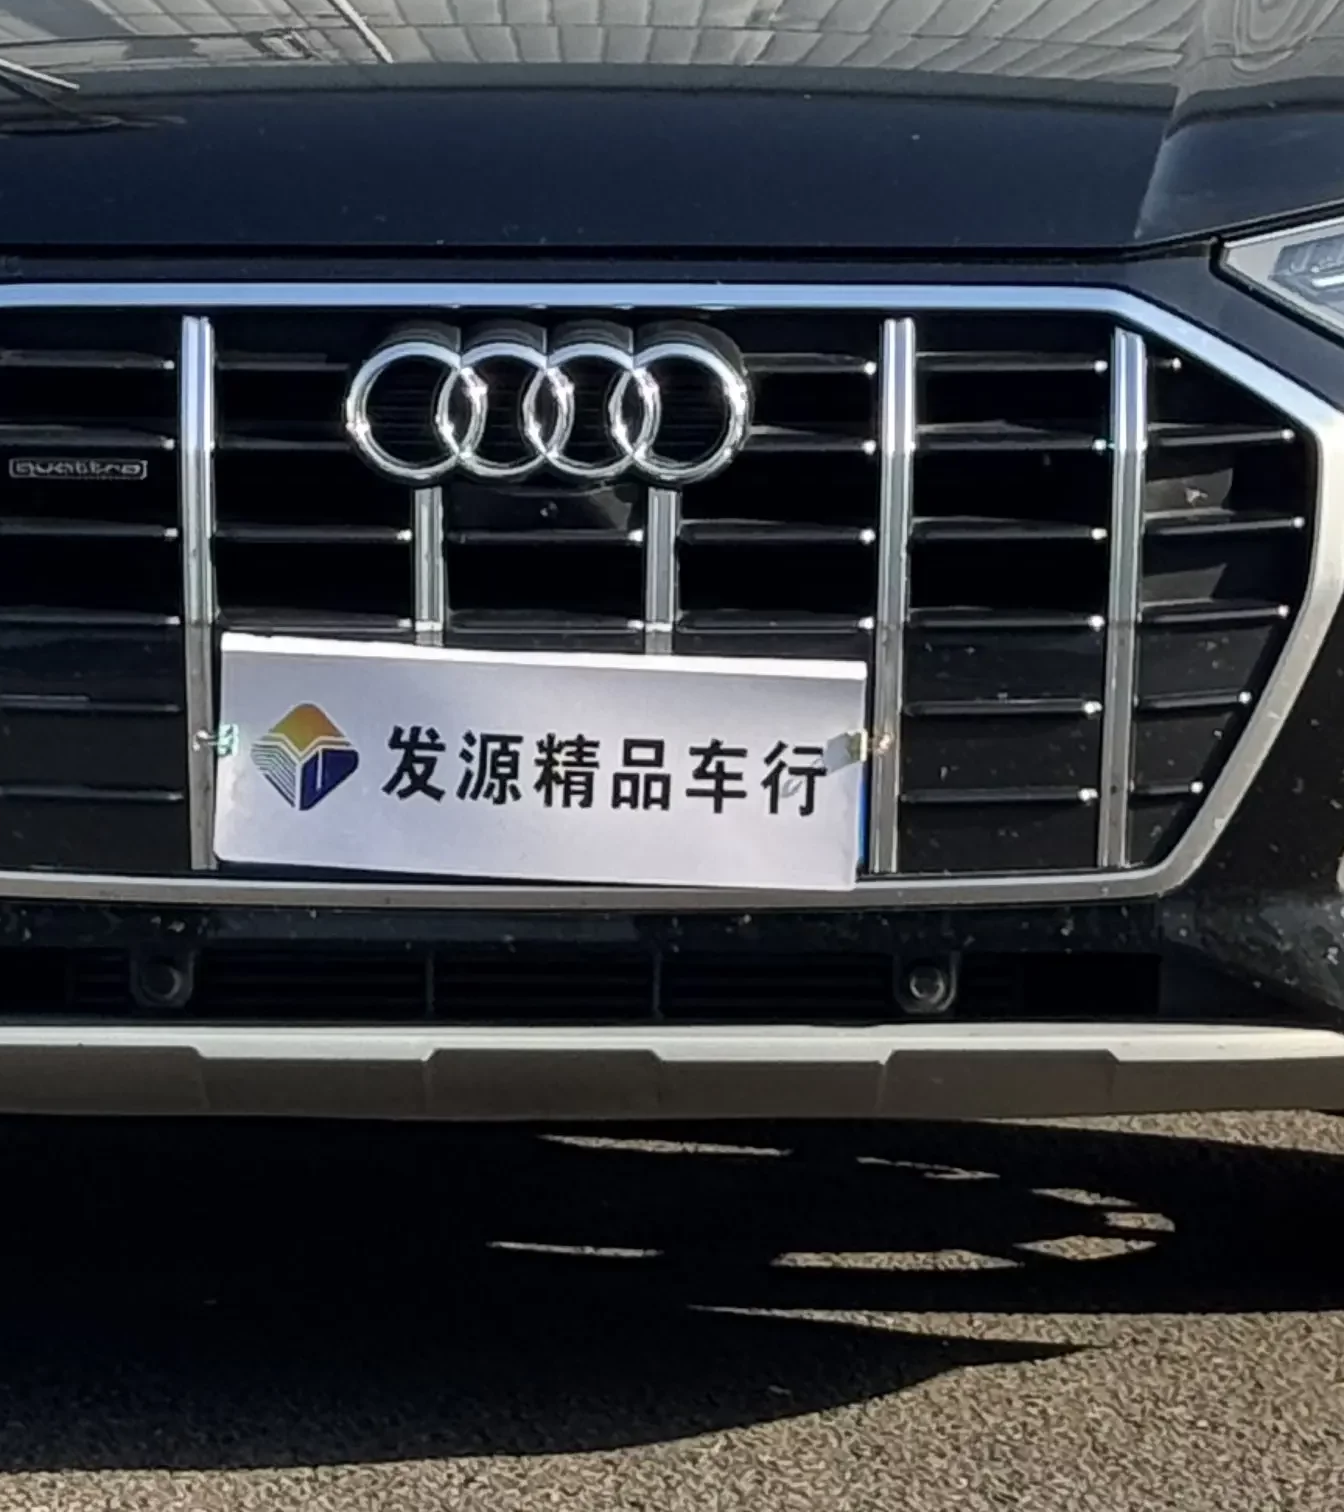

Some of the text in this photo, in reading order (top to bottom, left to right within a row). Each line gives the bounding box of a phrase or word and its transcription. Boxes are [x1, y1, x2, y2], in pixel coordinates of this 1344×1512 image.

[13, 459, 143, 478] quattro
[382, 724, 828, 817] 发源精品车行
